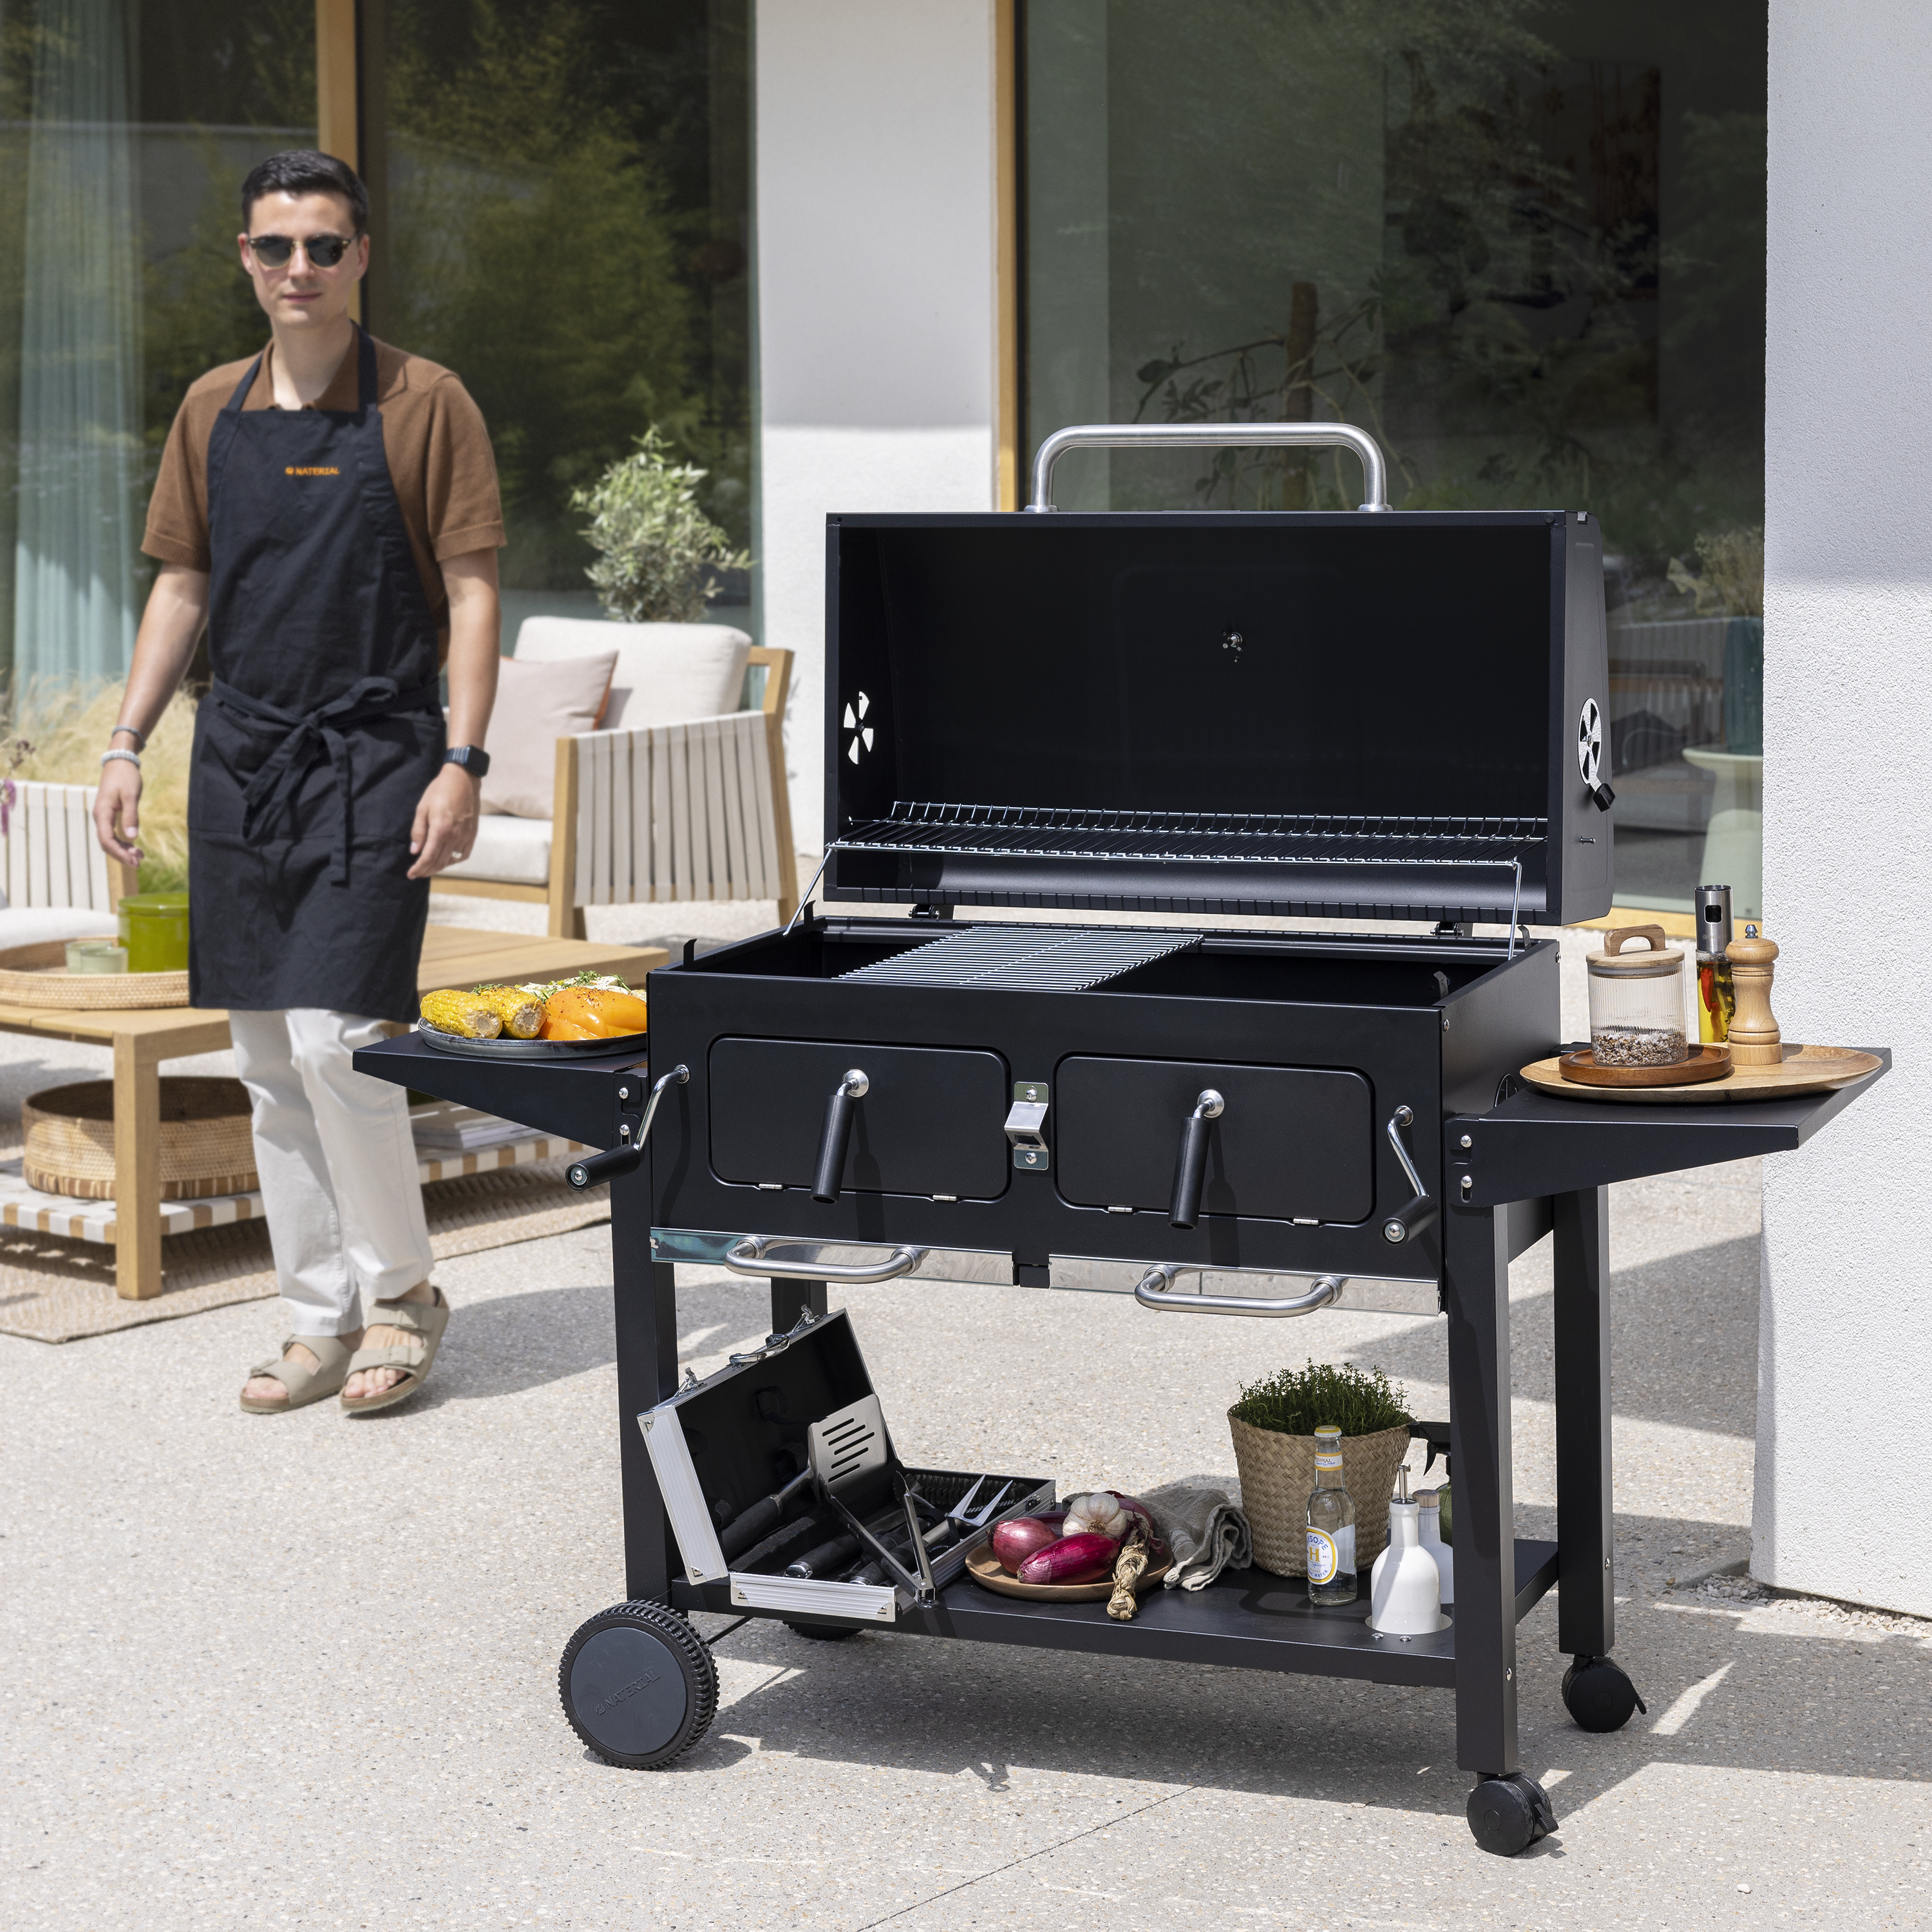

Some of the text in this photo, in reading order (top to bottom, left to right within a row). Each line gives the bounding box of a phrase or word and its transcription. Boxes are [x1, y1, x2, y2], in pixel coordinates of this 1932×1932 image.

[296, 467, 339, 475] NATERIAL
[1309, 1547, 1320, 1562] H
[605, 1671, 661, 1710] NATERIAL
